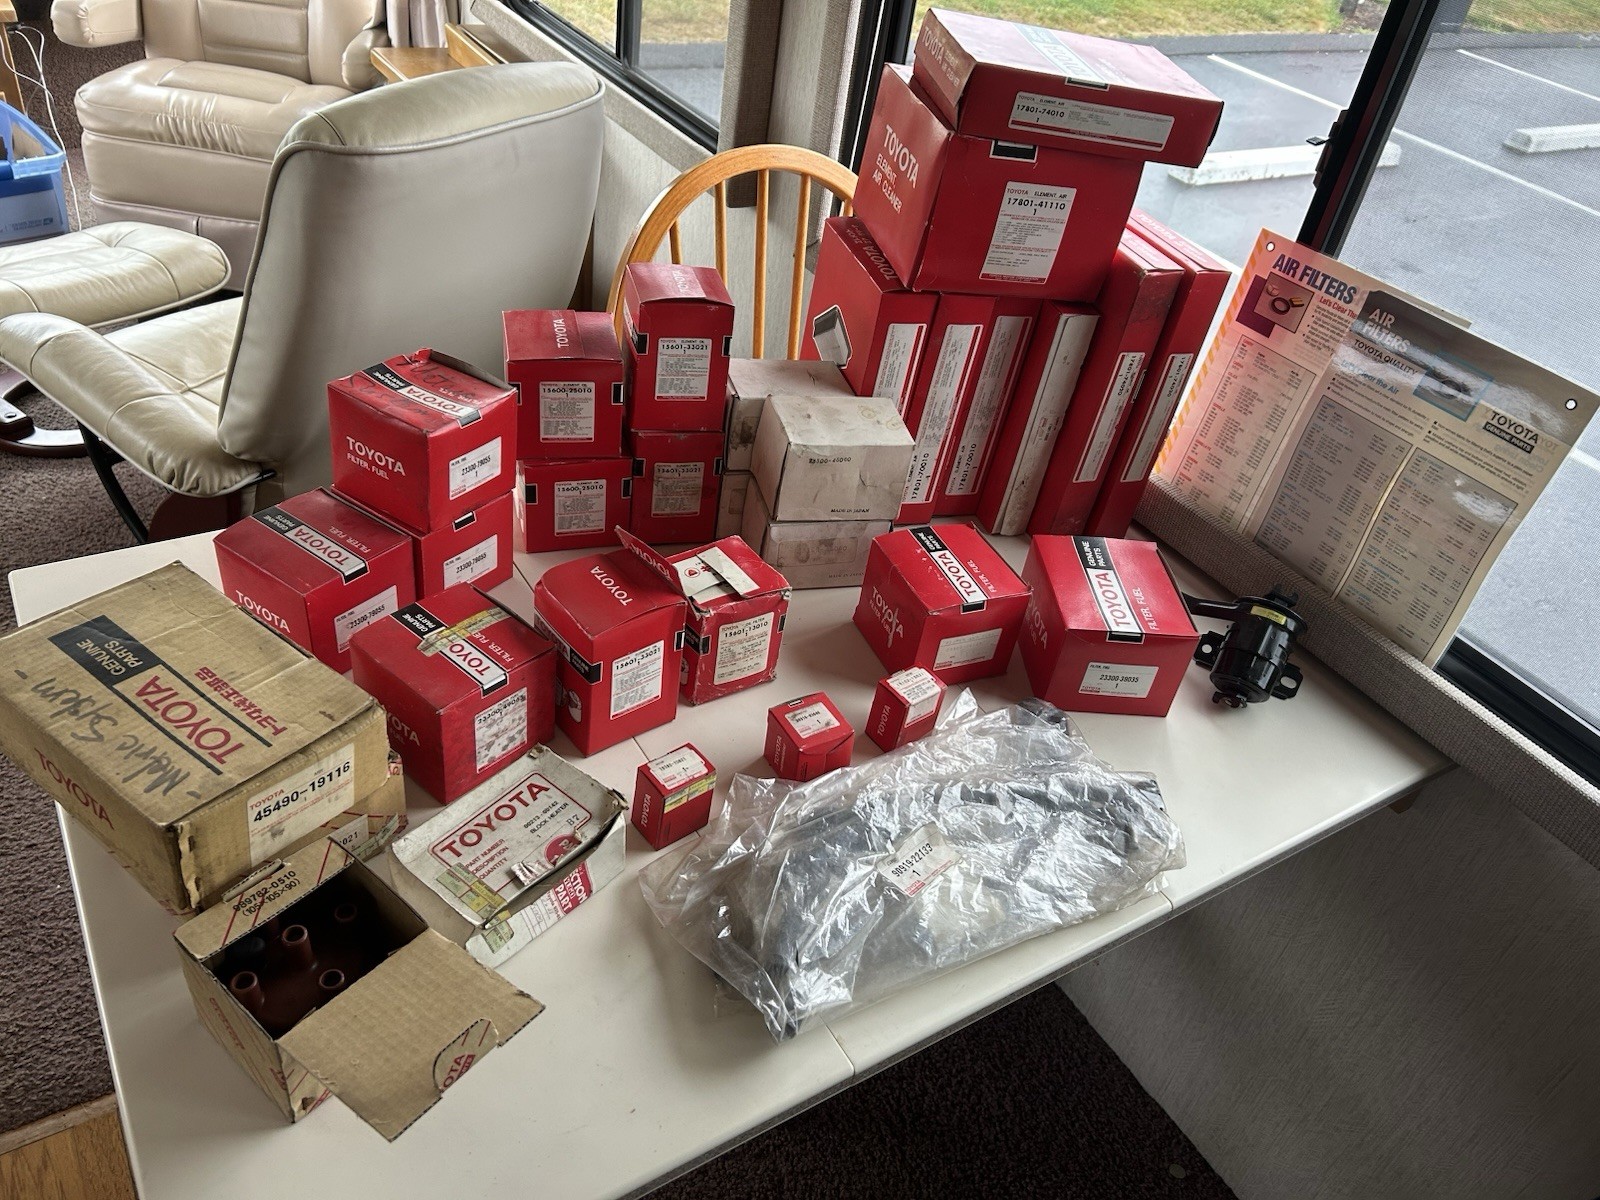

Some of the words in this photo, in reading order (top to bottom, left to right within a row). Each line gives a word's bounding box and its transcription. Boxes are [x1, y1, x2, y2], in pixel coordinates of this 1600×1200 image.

[921, 26, 944, 64] TOYOTA
[1016, 104, 1065, 118] 17801-74010
[884, 124, 919, 188] TOYOTA
[872, 168, 882, 186] AIR
[882, 180, 902, 214] CLEANER
[1007, 198, 1066, 210] 17801-41110
[863, 245, 898, 280] TOYOTA
[1272, 254, 1300, 278] AIR
[1299, 264, 1358, 305] FILTERS
[1319, 296, 1333, 309] Let's
[1331, 302, 1348, 315] Clear
[1369, 308, 1396, 328] AIR
[553, 318, 570, 348] TOYOTA
[1362, 321, 1411, 352] FILTERS
[1354, 339, 1383, 360] TOYOTA
[1383, 354, 1418, 376] QUALITY
[406, 386, 464, 414] TOYOTA
[1377, 375, 1389, 389] the
[1386, 381, 1400, 396] Air
[1490, 410, 1540, 446] TOYOTA
[346, 436, 406, 476] TOYOTA
[958, 443, 977, 491] 17801-70010
[372, 465, 389, 480] FUEL
[911, 452, 930, 500] 17801-70010
[263, 514, 289, 531] GENUINE
[275, 514, 295, 527] PARTS
[328, 526, 346, 538] FUEL
[294, 528, 349, 566] TOYOTA
[1082, 541, 1097, 566] GENUINE
[1096, 547, 1106, 566] PARTS
[937, 552, 976, 596] TOYOTA
[967, 560, 980, 573] FUEL
[590, 566, 633, 606] TOYOTA
[1095, 572, 1132, 627] TOYOTA
[1132, 587, 1146, 605] FUEL
[236, 590, 290, 633] TOYOTA
[350, 604, 385, 629] 23300-79055
[401, 613, 428, 632] GENUINE
[415, 613, 435, 629] PARTS
[872, 586, 903, 639] TOYOTA
[472, 632, 489, 644] FUE
[724, 621, 768, 638] 15601-13010
[76, 639, 126, 676] GENUINE
[104, 640, 143, 668] PARTS
[449, 641, 491, 676] TOYO
[615, 647, 661, 670] 15601-33021
[194, 666, 288, 736] トヨタ純正部品
[134, 675, 245, 765] TOYOTA
[877, 705, 892, 736] TOYOTA
[116, 734, 191, 796] Metric
[34, 748, 114, 830] TOYOTA
[250, 789, 285, 810] TOYOTA
[254, 762, 350, 822] 45490-19116
[440, 782, 551, 858] TOYOTA
[530, 818, 549, 834] BLOCK
[548, 803, 569, 820] HEATER
[641, 794, 651, 827] TOYOTA
[465, 855, 481, 869] PART
[481, 838, 506, 857] NUMBER
[471, 846, 509, 875] DESCRIPTION
[479, 857, 508, 879] QUANTITY
[892, 843, 933, 877] 90919-22133
[555, 884, 572, 912] PART
